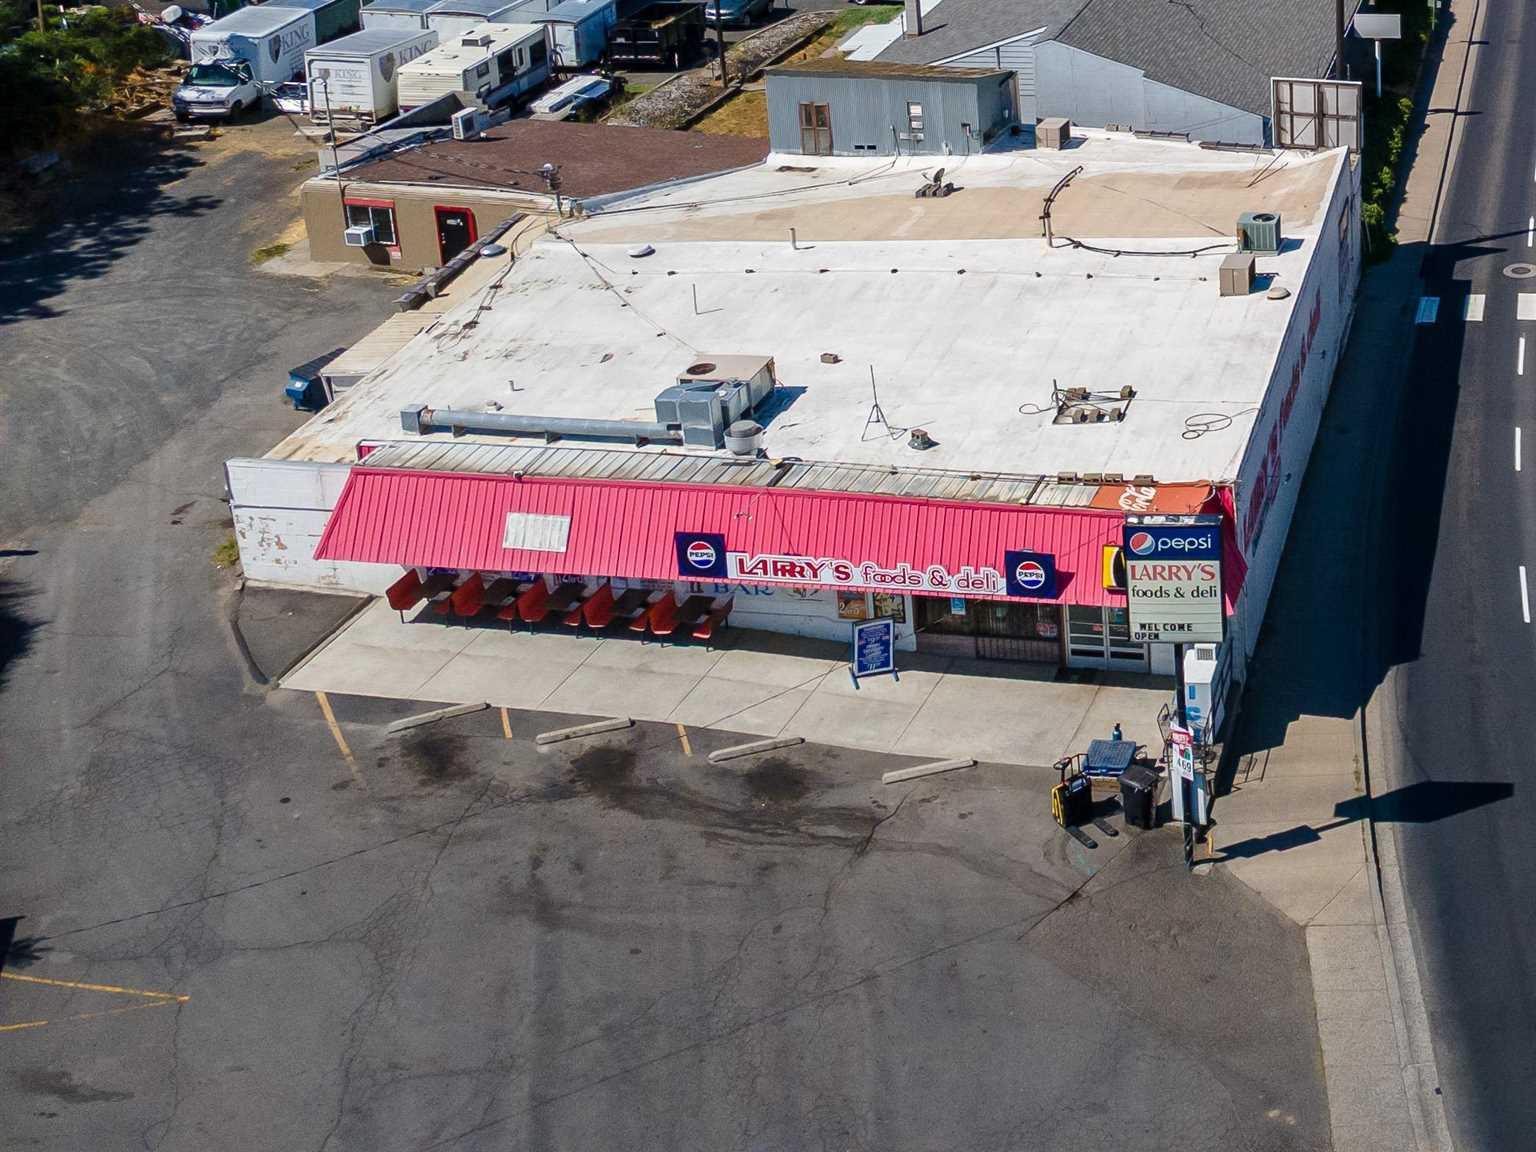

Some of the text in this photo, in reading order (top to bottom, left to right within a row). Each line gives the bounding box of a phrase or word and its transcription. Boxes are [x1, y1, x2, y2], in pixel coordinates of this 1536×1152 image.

[281, 24, 310, 49] KING
[1158, 534, 1212, 552] pepsi
[737, 556, 998, 592] LARRY'S foods & deli
[1018, 571, 1043, 579] PEPSI
[1129, 562, 1217, 582] LARRY'S
[1131, 585, 1217, 599] foods & deli
[1134, 632, 1160, 641] OPEN
